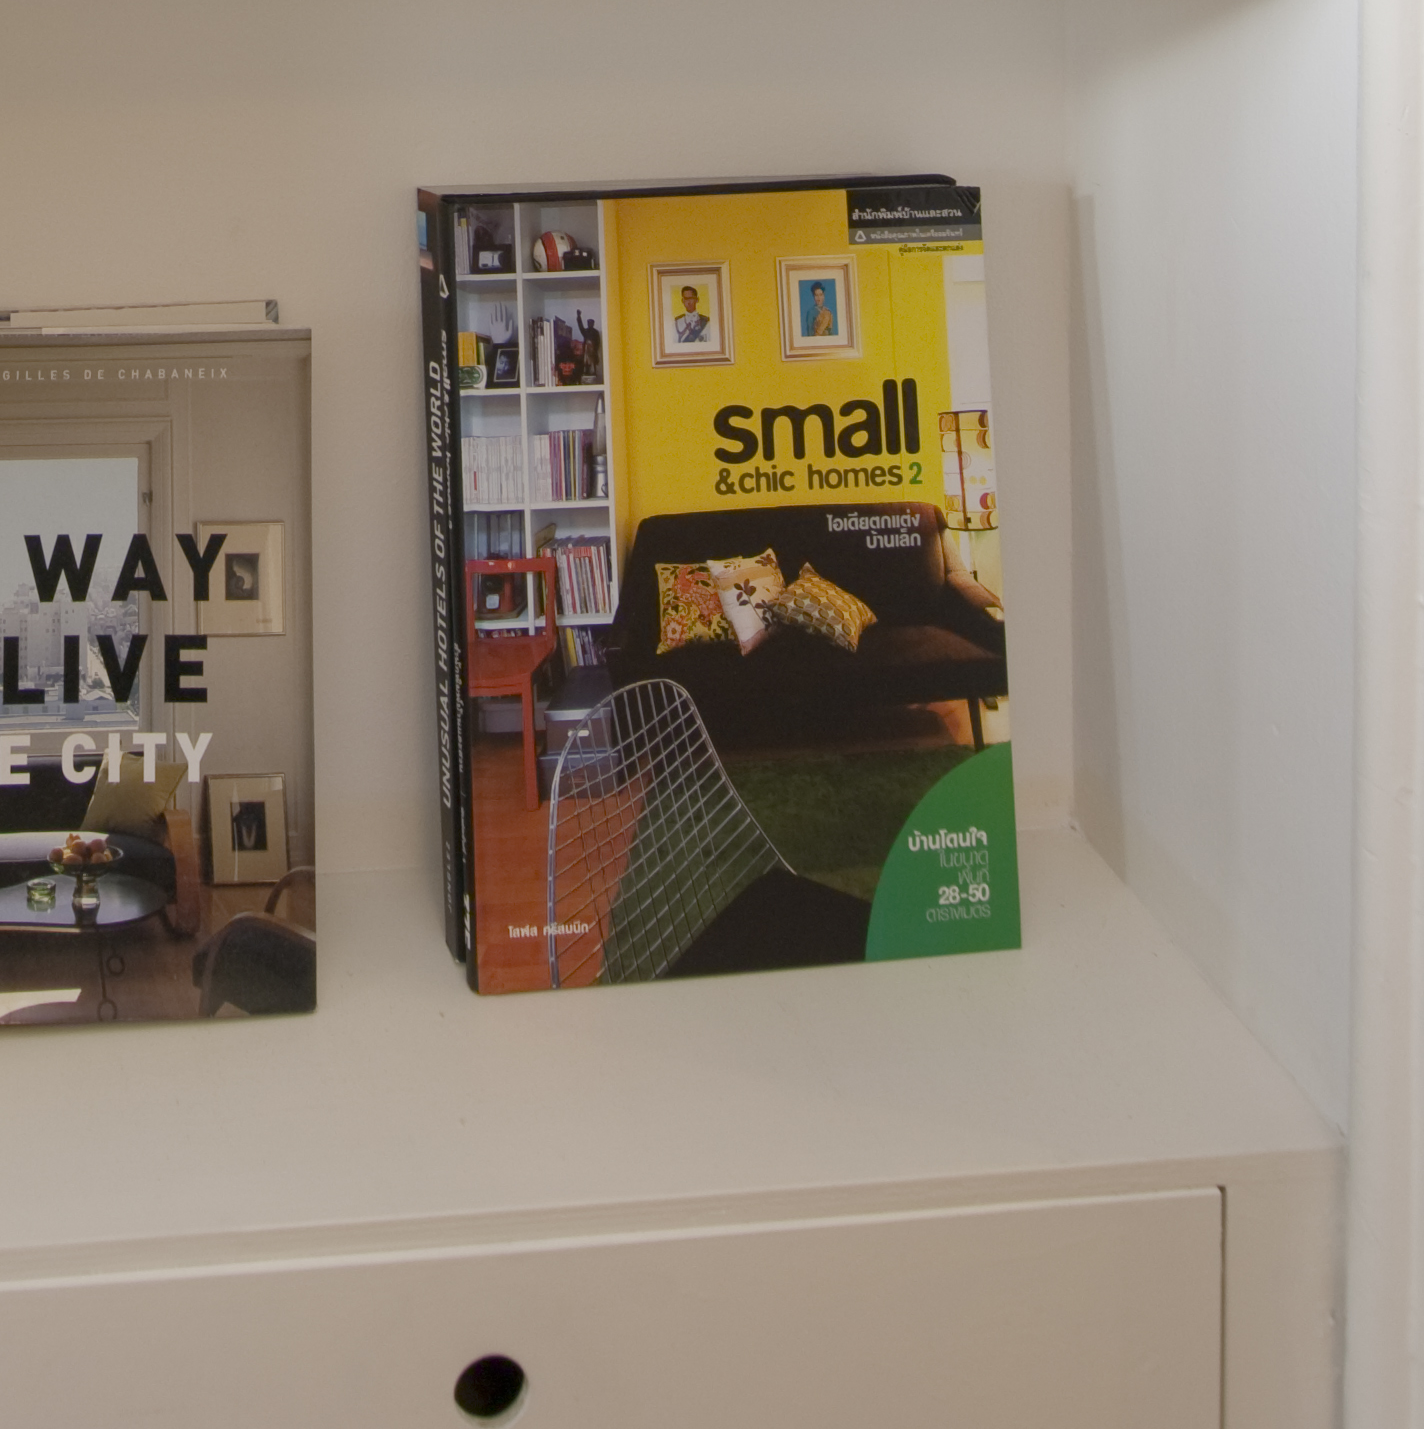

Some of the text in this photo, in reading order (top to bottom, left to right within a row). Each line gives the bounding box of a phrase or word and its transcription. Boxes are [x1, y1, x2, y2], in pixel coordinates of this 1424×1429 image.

[2, 369, 71, 381] GILLES
[84, 369, 105, 380] DE
[117, 367, 228, 380] CHABANEIX
[713, 378, 920, 464] small
[808, 463, 903, 491] homes
[909, 462, 923, 485] 2
[23, 532, 228, 603] WAY
[430, 361, 452, 808] UNUSUAL HOTELS OF THE WORLD
[2, 634, 208, 706] LIVE
[61, 732, 214, 785] CITY
[938, 883, 990, 905] 28-50
